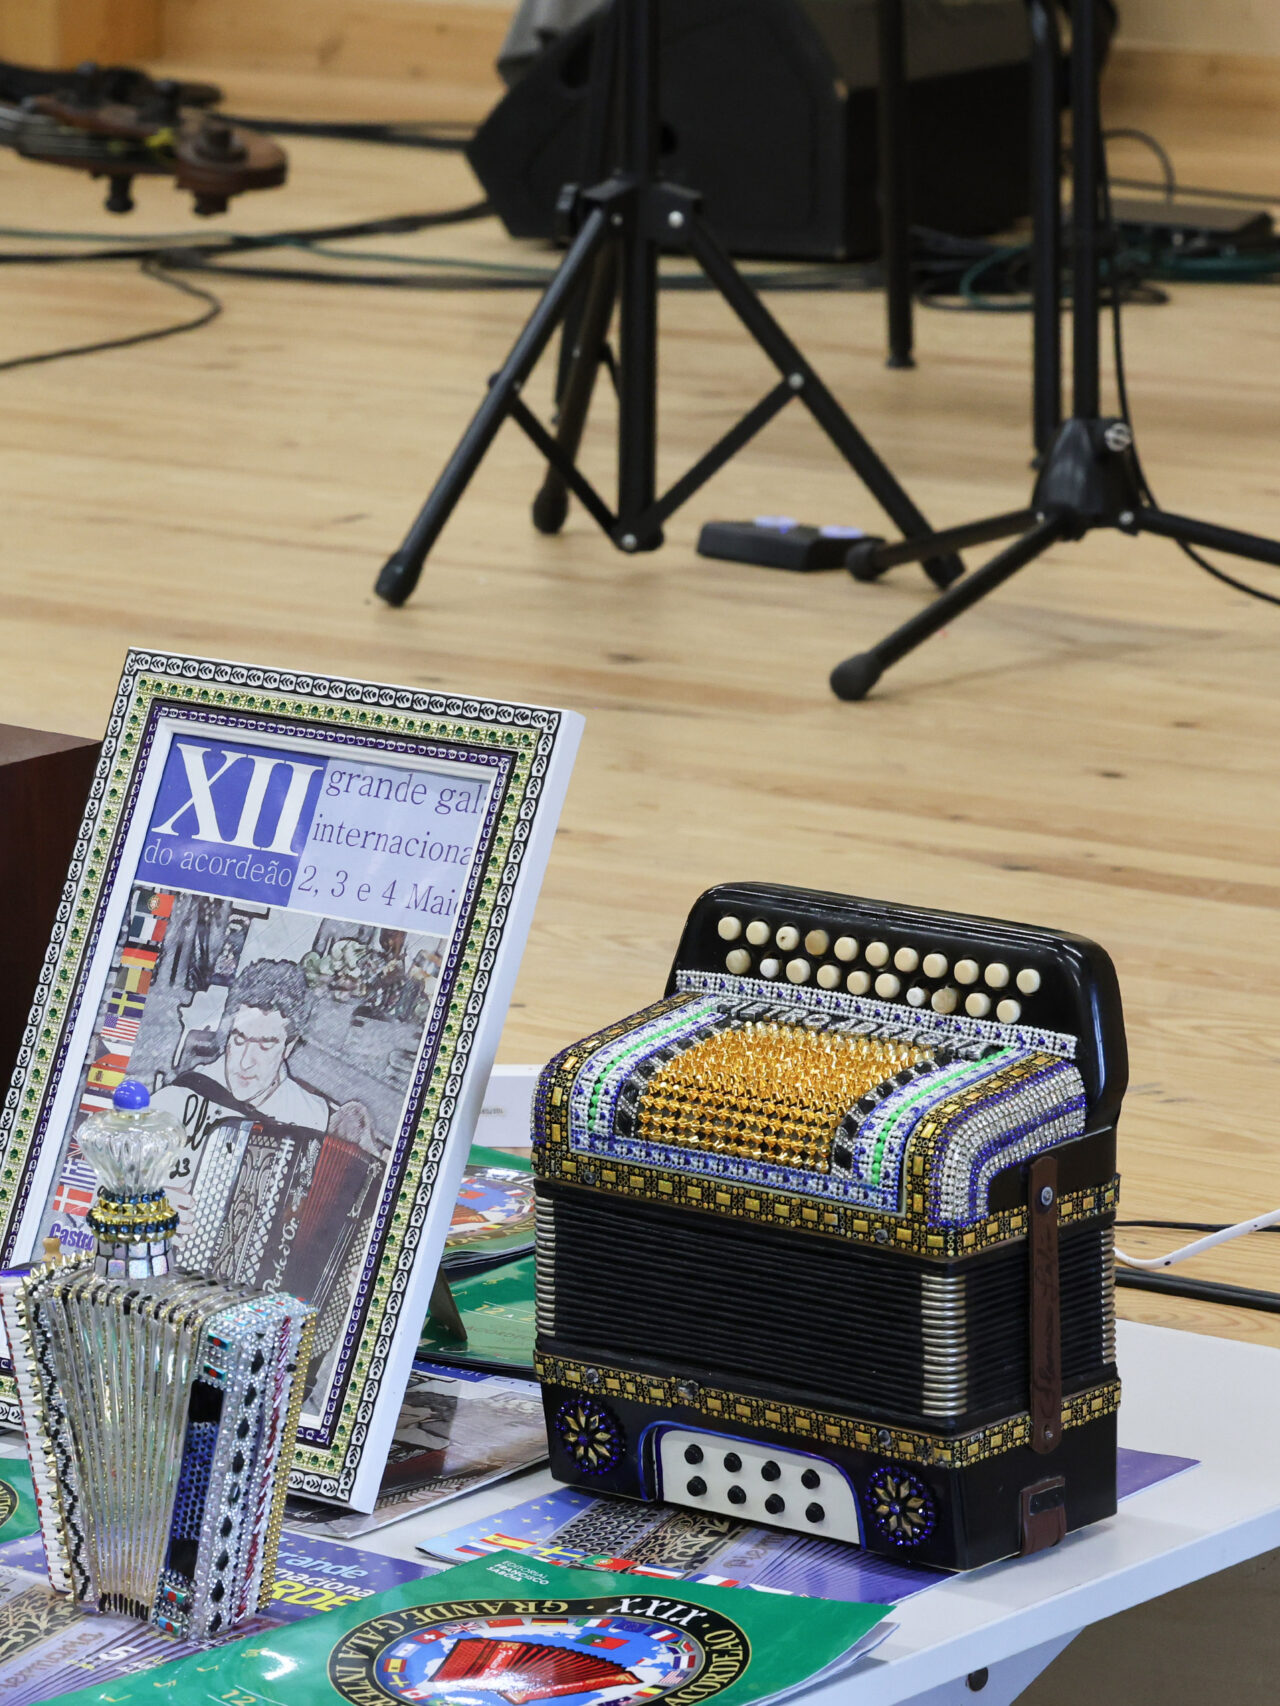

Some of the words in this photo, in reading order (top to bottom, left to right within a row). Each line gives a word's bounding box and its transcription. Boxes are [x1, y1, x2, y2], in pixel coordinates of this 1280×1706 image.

[151, 742, 324, 858] XII
[325, 768, 428, 806] grande
[143, 837, 174, 867] do
[180, 854, 293, 888] acordeão
[330, 869, 349, 899] 3
[357, 882, 371, 902] e
[381, 879, 398, 907] 4
[494, 1563, 550, 1585] FRANCISCO
[501, 1560, 549, 1580] EDITORIAL
[399, 1599, 569, 1627] GRANDE
[606, 1597, 709, 1628] XXIX
[338, 1618, 406, 1661] GALA
